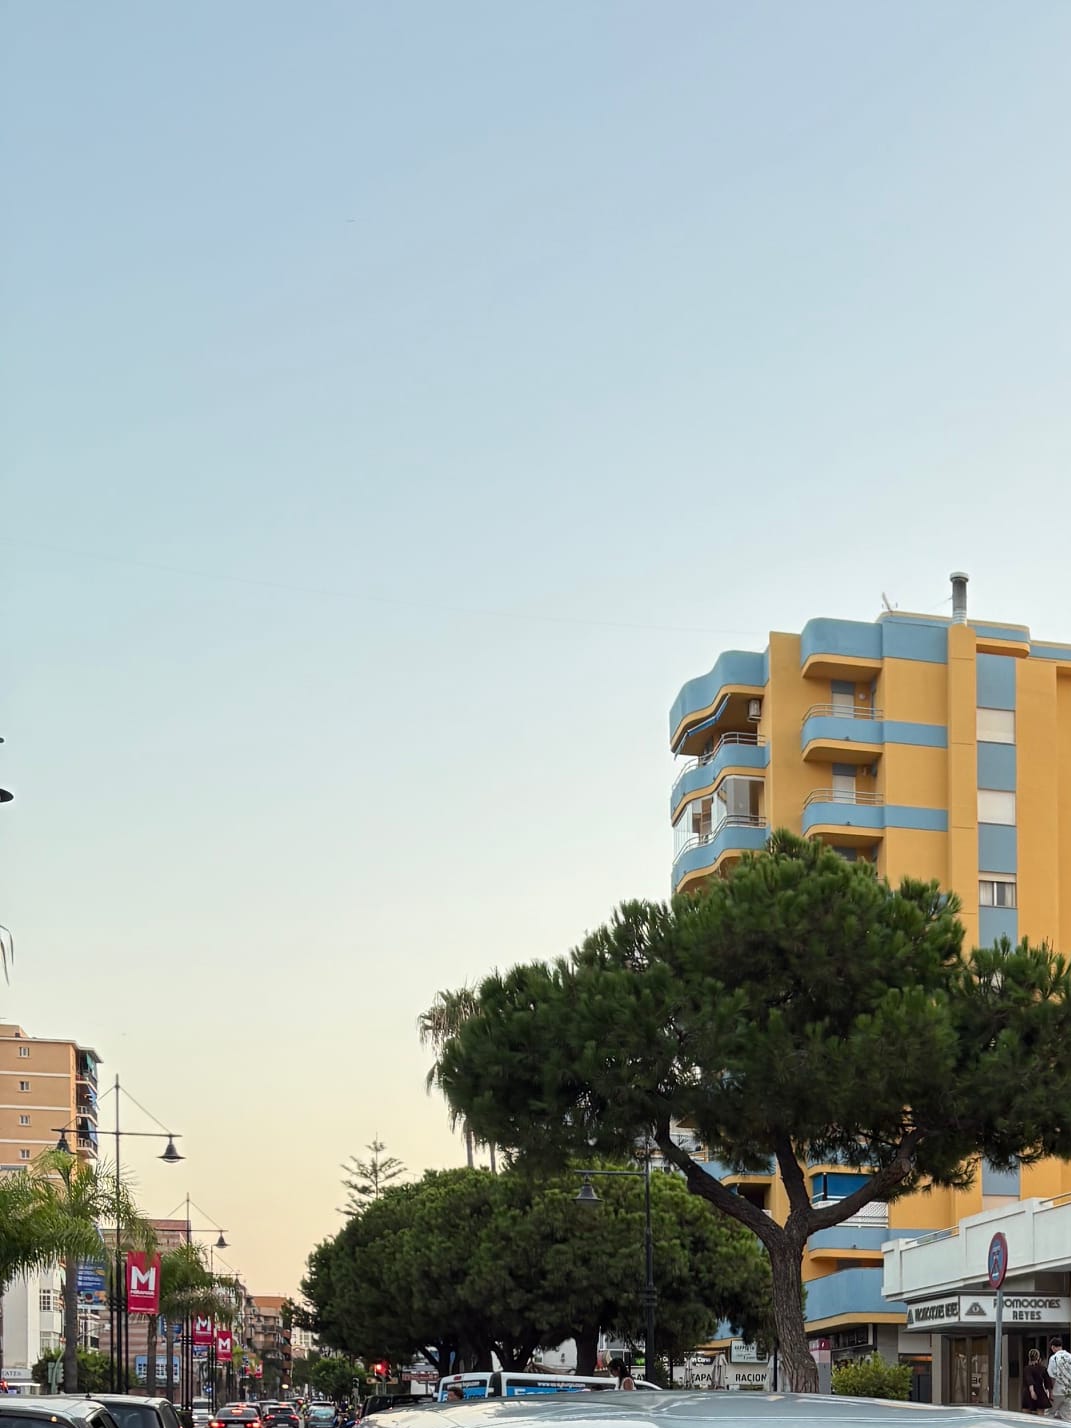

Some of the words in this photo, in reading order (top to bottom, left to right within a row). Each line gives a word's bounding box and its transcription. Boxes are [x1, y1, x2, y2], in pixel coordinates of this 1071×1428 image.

[131, 1265, 156, 1291] M
[1012, 1311, 1042, 1321] REYES
[218, 1338, 231, 1350] M
